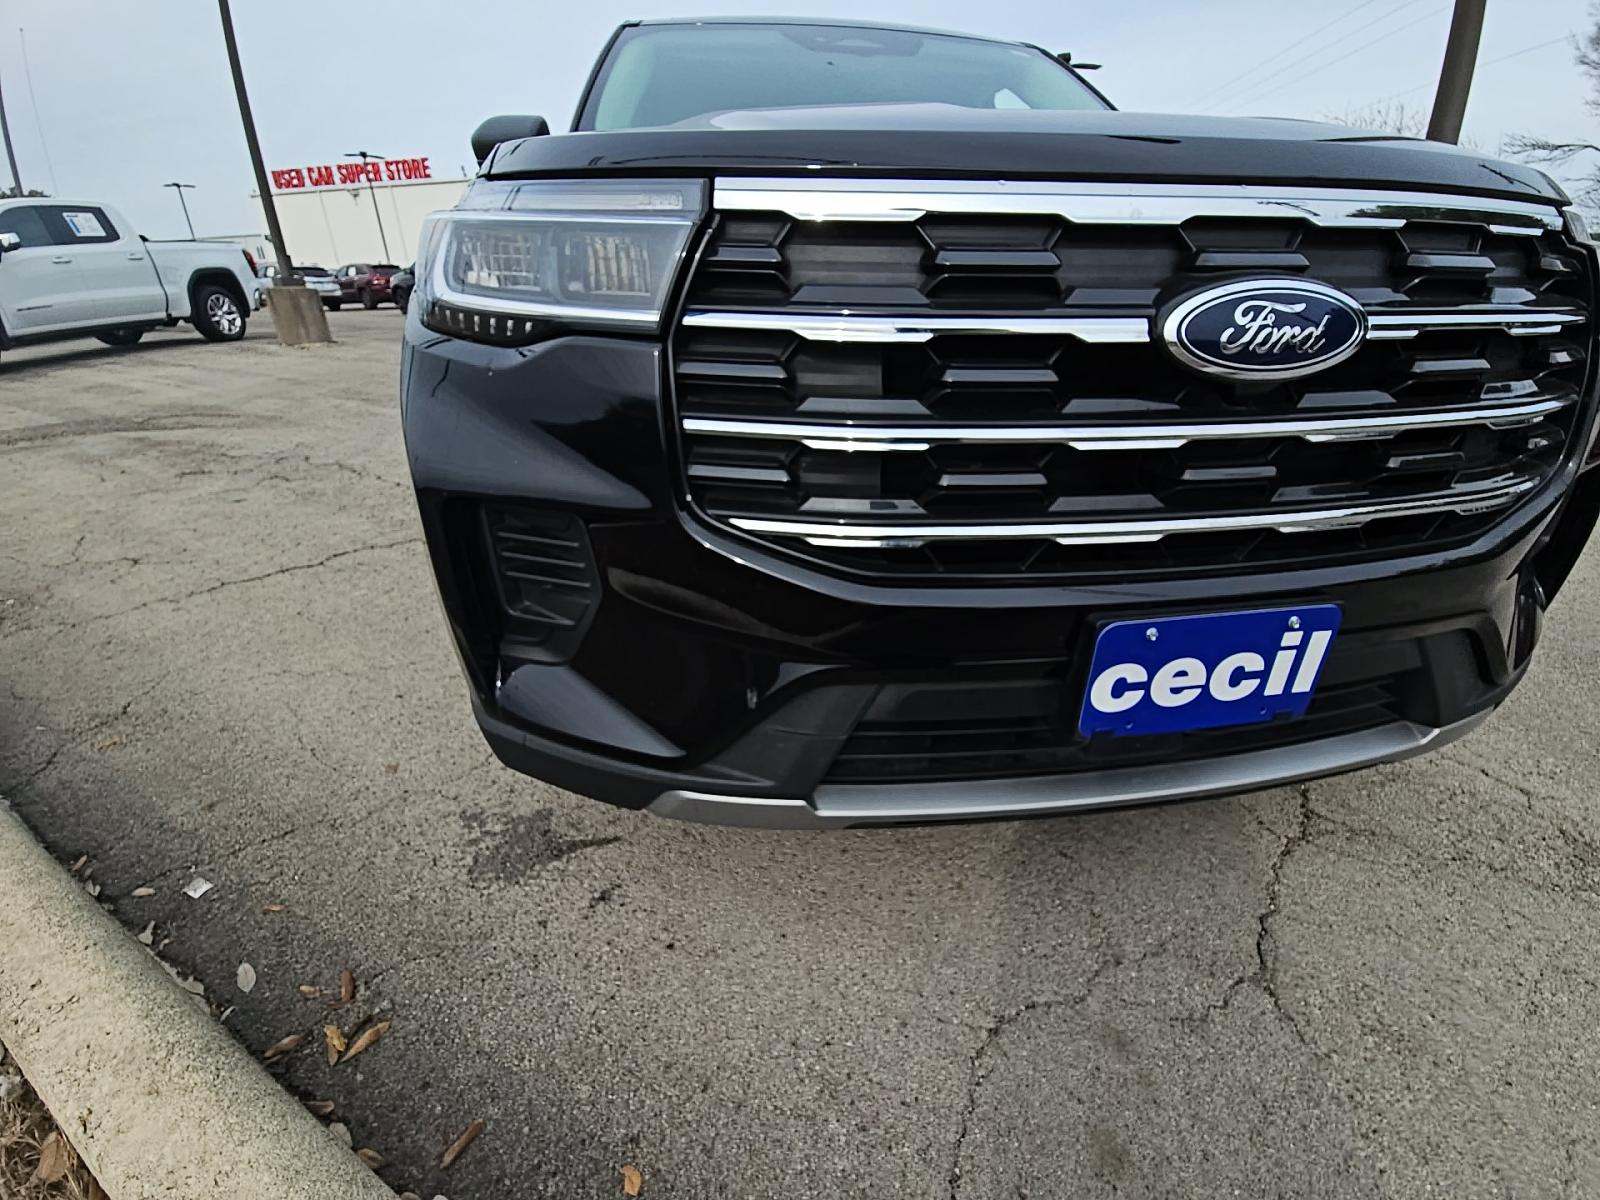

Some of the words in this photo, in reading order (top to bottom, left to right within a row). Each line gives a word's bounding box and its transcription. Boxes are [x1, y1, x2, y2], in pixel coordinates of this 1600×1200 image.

[271, 169, 305, 189] USED
[307, 165, 335, 186] CAR
[337, 162, 383, 184] SUPER
[385, 158, 431, 180] STORE
[1220, 300, 1331, 355] Ford
[1090, 630, 1333, 713] cecil
